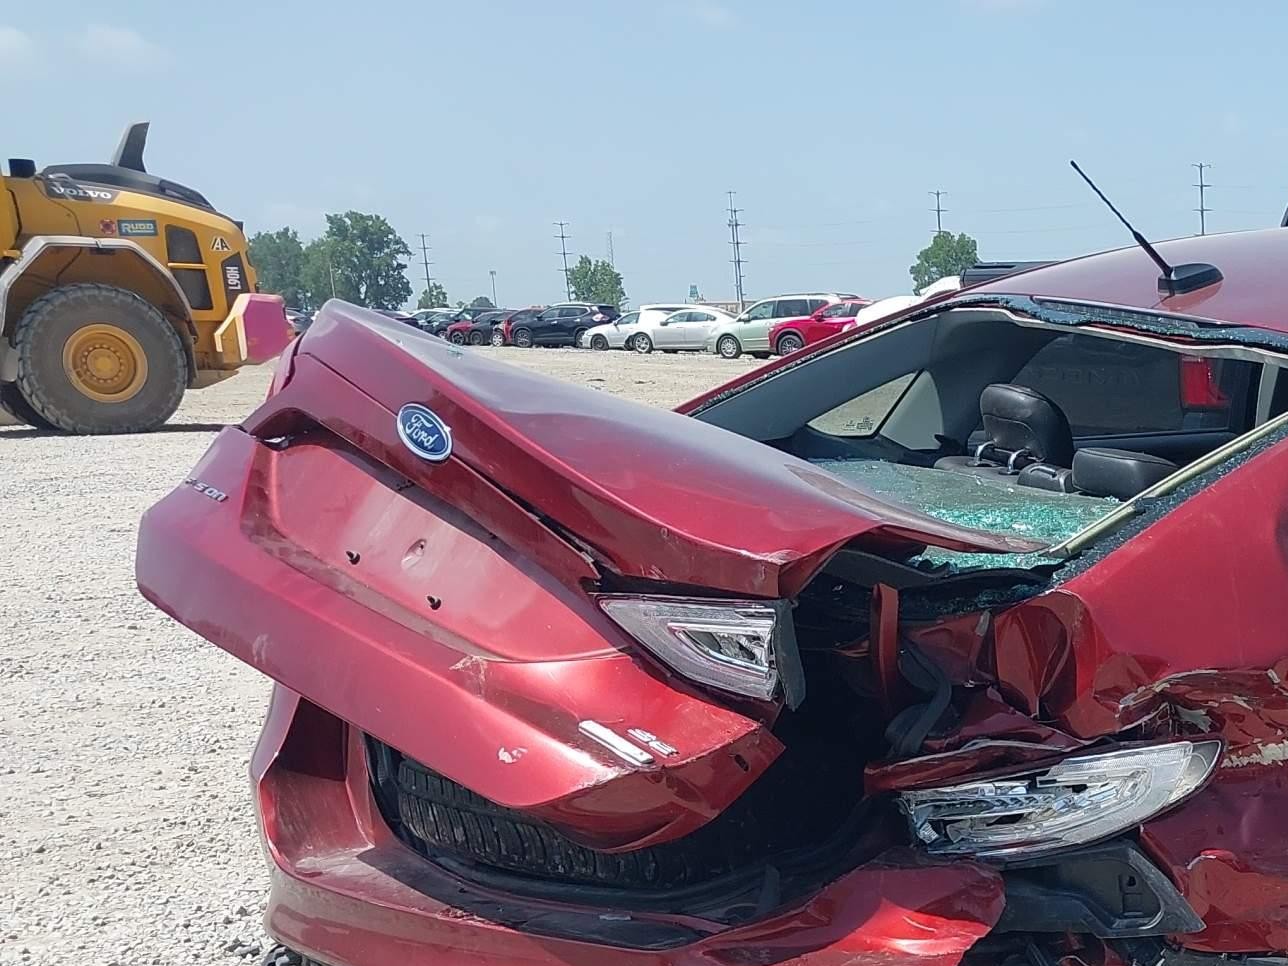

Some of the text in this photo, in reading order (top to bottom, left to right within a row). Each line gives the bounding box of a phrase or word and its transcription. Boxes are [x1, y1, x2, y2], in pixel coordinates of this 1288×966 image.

[51, 185, 112, 199] VOLVO
[225, 266, 242, 290] L90H
[405, 413, 439, 449] Ford
